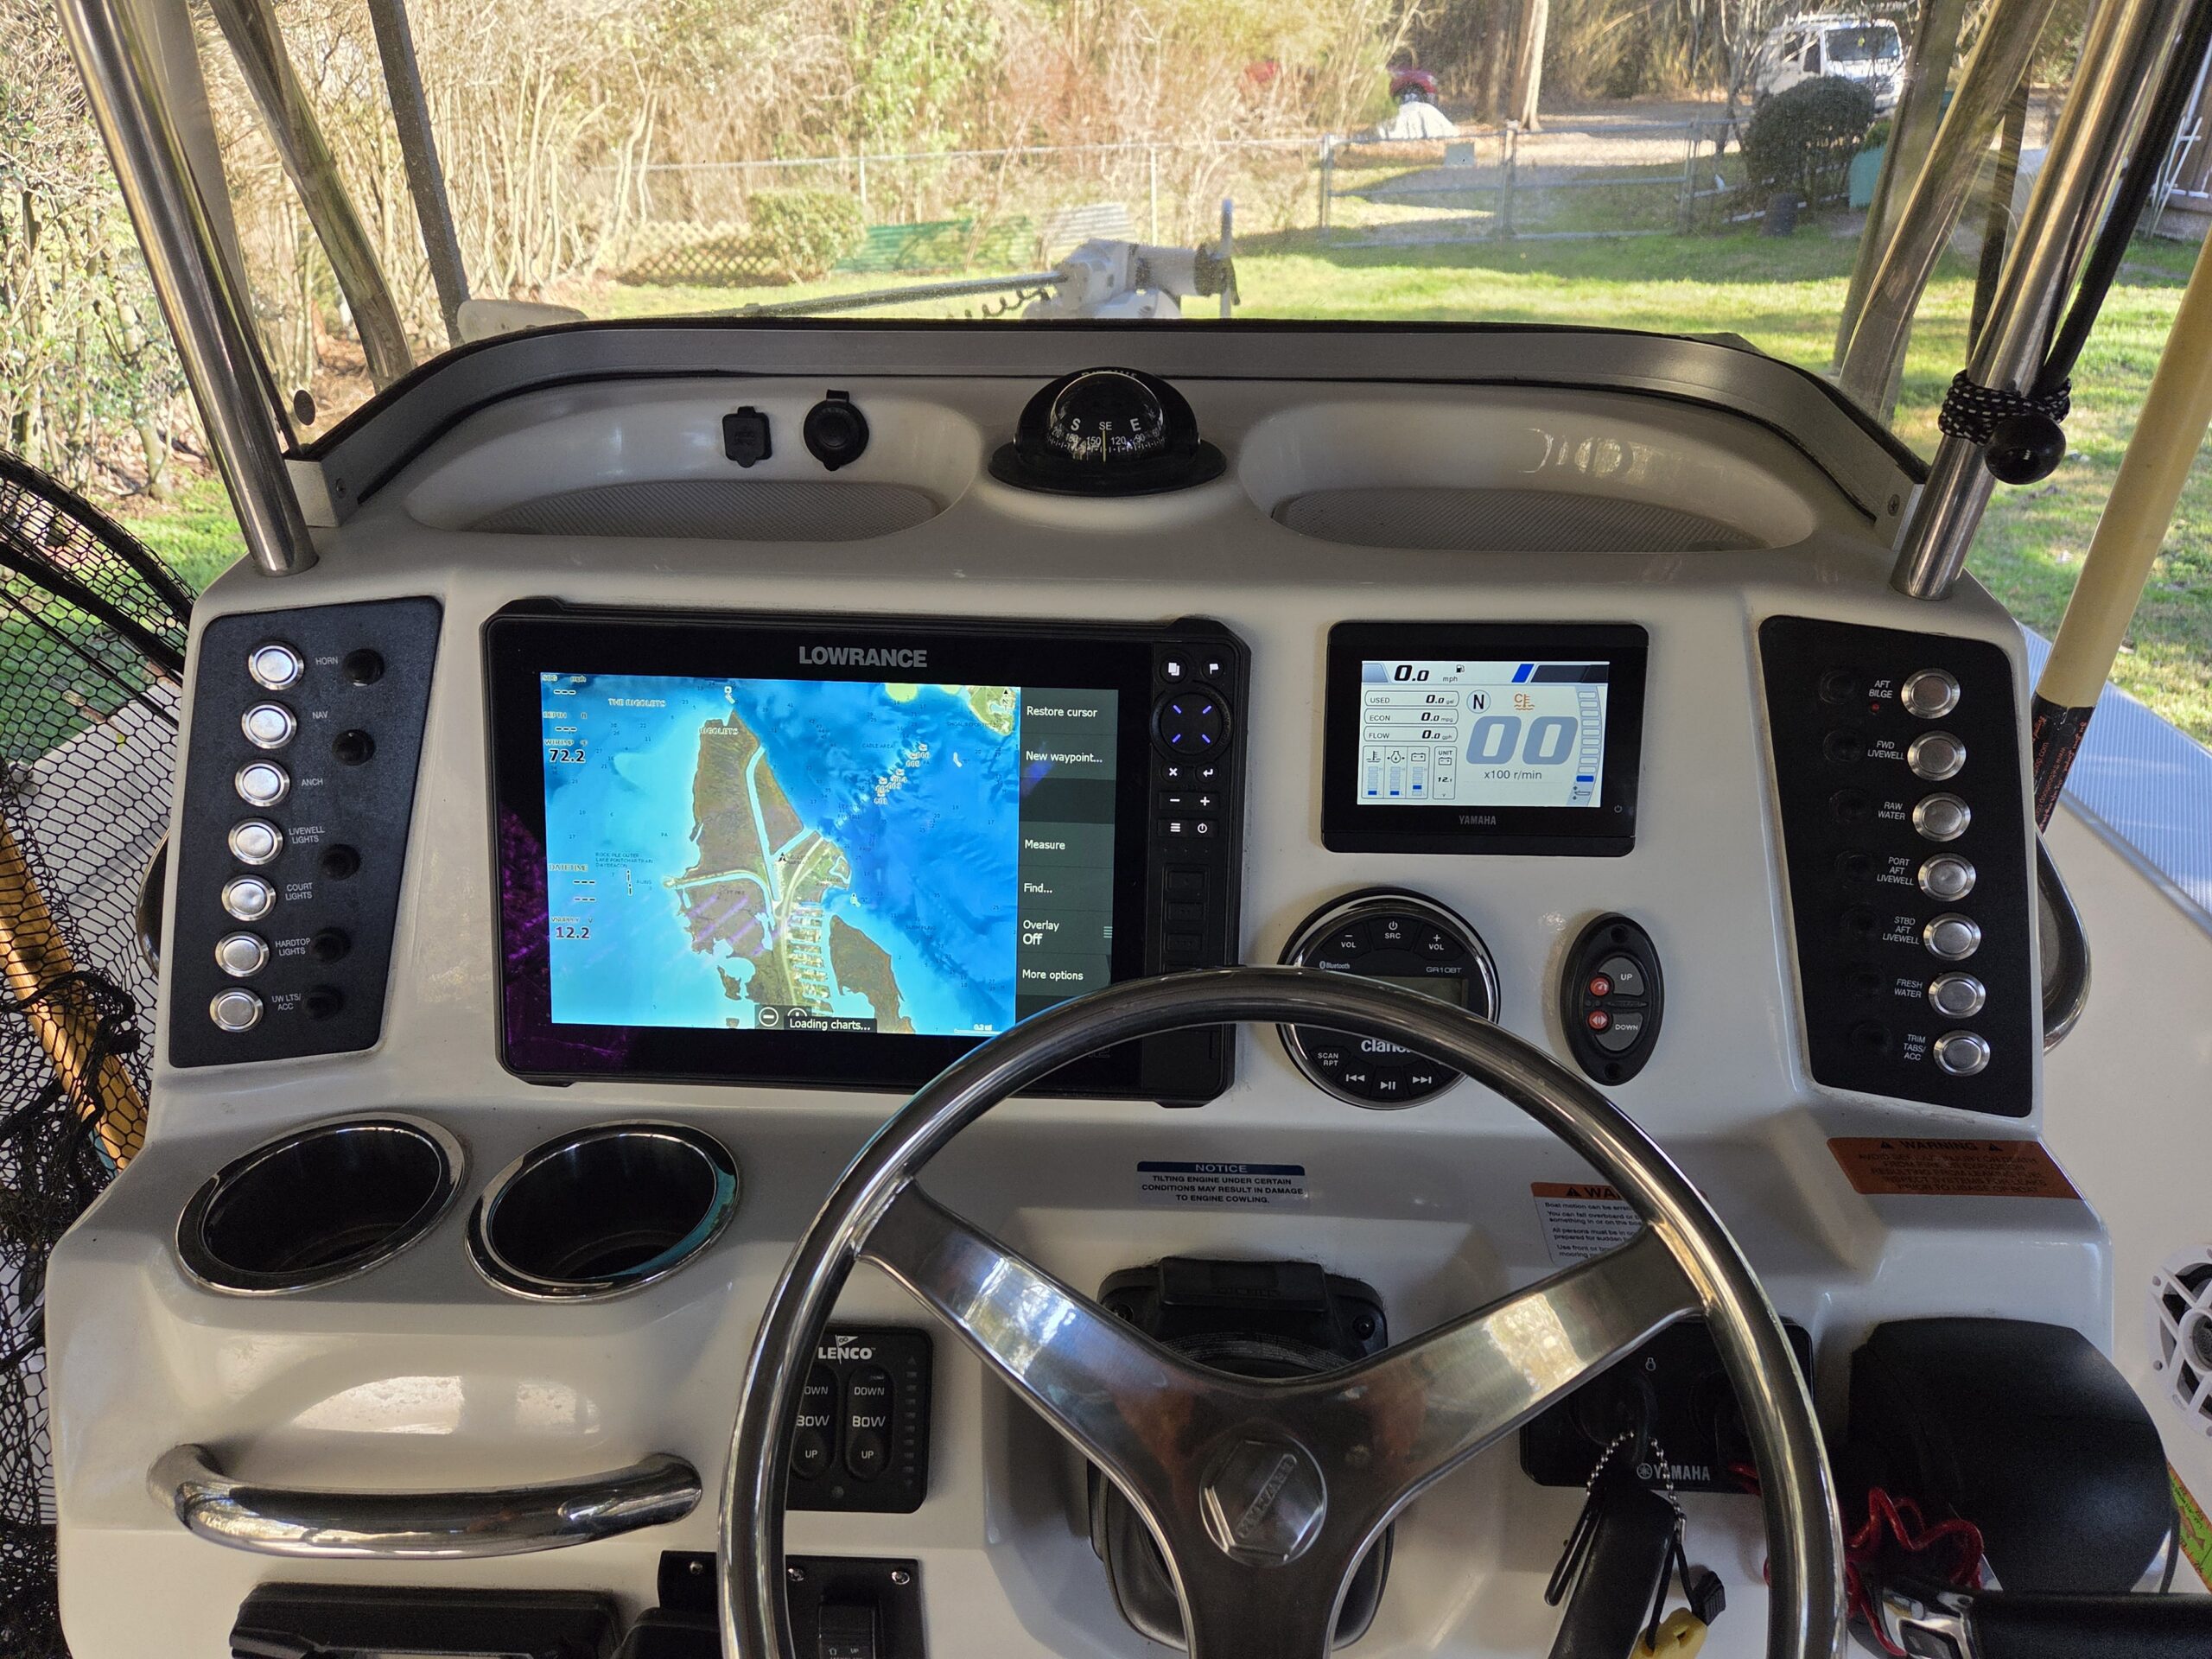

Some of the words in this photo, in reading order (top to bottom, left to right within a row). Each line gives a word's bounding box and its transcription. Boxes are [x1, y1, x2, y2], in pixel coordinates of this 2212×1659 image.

[1071, 418, 1081, 431] S
[1099, 422, 1112, 430] SE
[1130, 418, 1141, 432] E
[1087, 436, 1101, 445] 150
[1111, 436, 1126, 445] 120
[315, 657, 339, 666] HORN
[799, 646, 927, 668] LOWRANCE
[1395, 664, 1429, 682] 0.0
[1426, 695, 1445, 703] 0.0
[1869, 690, 1893, 698] BILGE
[1473, 695, 1484, 710] N
[1027, 706, 1065, 717] Restore
[1067, 708, 1097, 718] cursor
[1421, 712, 1440, 721] 0.0
[1421, 730, 1440, 739] 0.0
[1465, 715, 1579, 766] 00
[1877, 741, 1895, 749] FWD
[550, 748, 586, 762] 72.2
[1026, 750, 1048, 762] New
[1051, 753, 1103, 764] waypoint...
[1867, 749, 1904, 760] LIVEWELL
[1484, 771, 1510, 779] x100
[1513, 771, 1542, 779] r/min
[301, 778, 323, 787] ANCH
[1884, 802, 1903, 810] RAW
[1878, 810, 1905, 820] WATER
[1459, 816, 1497, 826] YAMAHA
[289, 826, 325, 836] LIVEWELL
[292, 835, 320, 843] LIGHTS
[1025, 840, 1066, 850] Measure
[1889, 857, 1910, 866] PORT
[1890, 866, 1905, 874] AFT
[1877, 874, 1915, 886] LIVEWELL
[286, 882, 313, 893] COURT
[1023, 883, 1052, 893] Find...
[285, 892, 313, 901] LIGHTS
[1023, 920, 1059, 932] Overlay
[1894, 917, 1916, 925] STBD
[556, 926, 591, 939] 12.2
[1895, 925, 1911, 934] AFT
[275, 938, 311, 949] HARDTOP
[1022, 933, 1043, 945] Off
[1882, 934, 1920, 945] LIVEWELL
[278, 947, 306, 956] LIGHTS
[1022, 969, 1047, 980] More
[1049, 969, 1084, 982] options
[1897, 979, 1923, 988] FRESH
[1894, 988, 1922, 998] WATER
[271, 995, 283, 1004] UW
[285, 994, 302, 1002] LTS/
[277, 1001, 294, 1011] ACC
[790, 1018, 828, 1031] Loading
[830, 1020, 871, 1031] charts...
[1361, 1039, 1411, 1052] clar
[1904, 1043, 1926, 1053] TABS/
[1904, 1052, 1922, 1061] ACC
[1901, 1141, 1977, 1151] WARNING
[1195, 1164, 1248, 1173] NOTICE
[817, 1347, 873, 1360] LENCO
[804, 1386, 828, 1395] OWN
[854, 1387, 885, 1395] DOWN
[797, 1414, 830, 1427] BOW
[852, 1416, 886, 1427] BOW
[804, 1450, 818, 1459] UP
